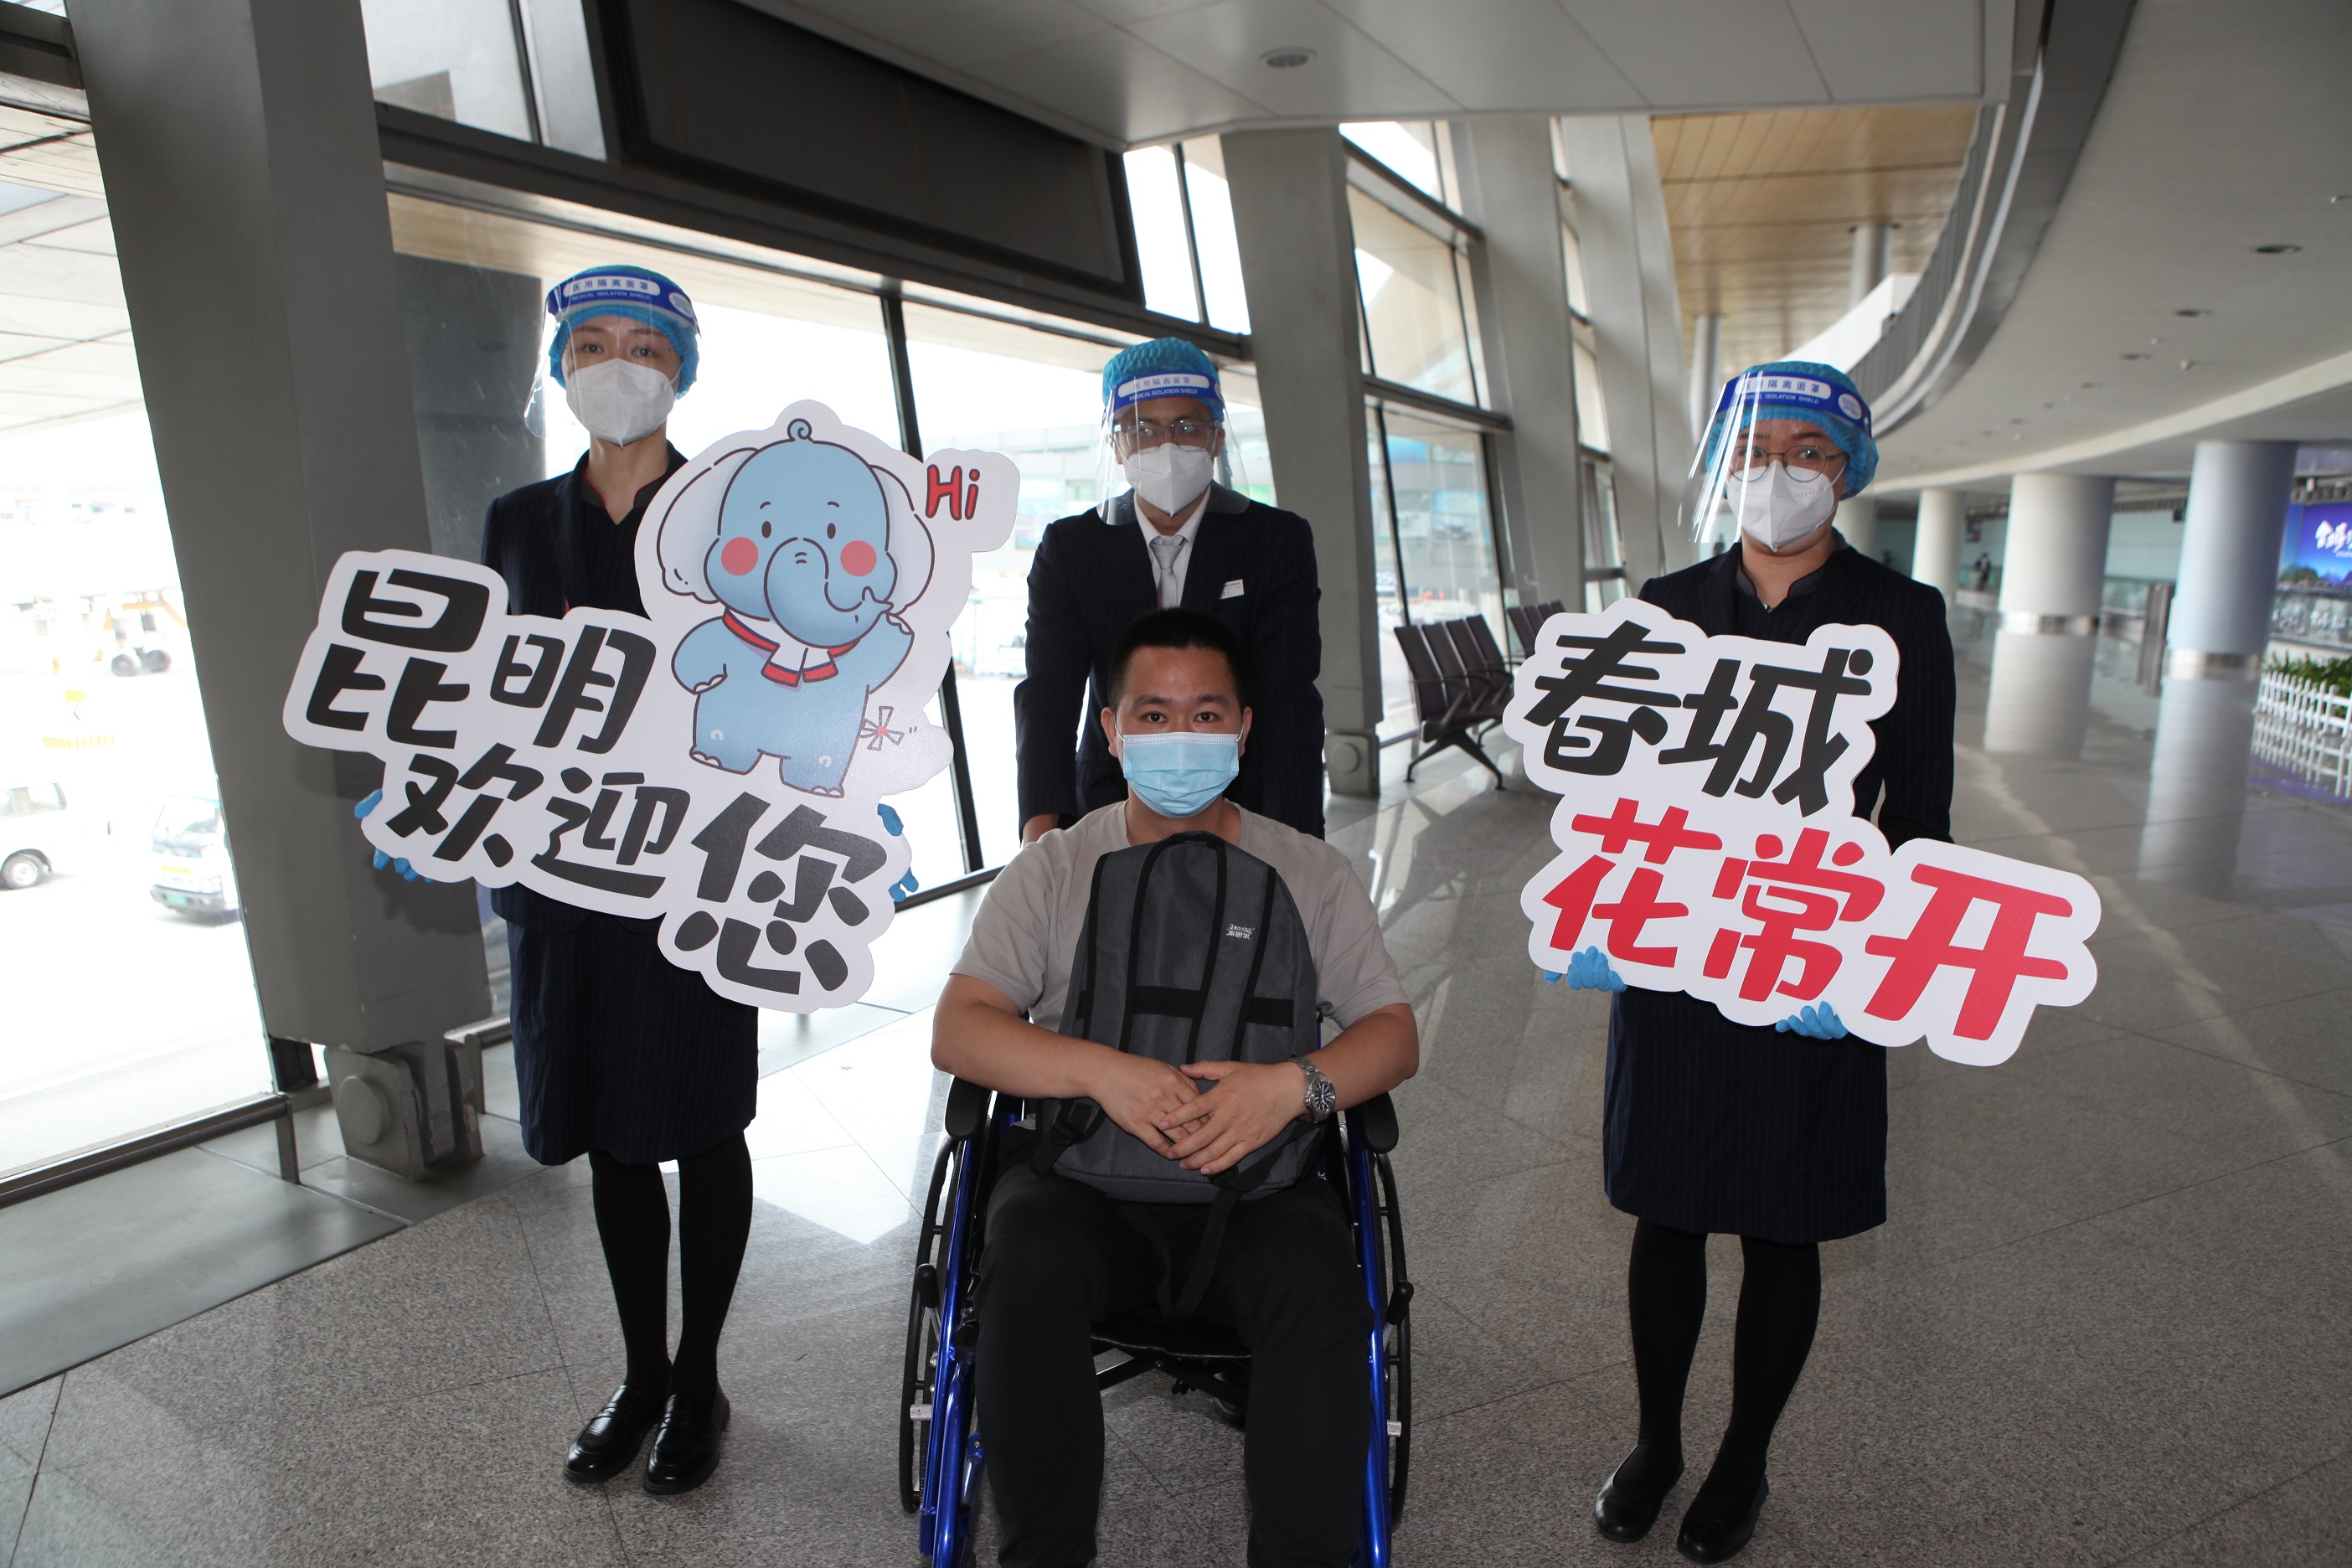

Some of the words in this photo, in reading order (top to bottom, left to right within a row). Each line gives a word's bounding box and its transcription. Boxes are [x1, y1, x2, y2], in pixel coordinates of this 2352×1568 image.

[926, 464, 981, 521] Hi
[1798, 395, 1819, 404] SHIELD
[306, 568, 658, 755] 昆明
[1523, 620, 1874, 818] 春城
[385, 742, 889, 996] 欢迎您
[1542, 797, 2073, 1041] 花常开
